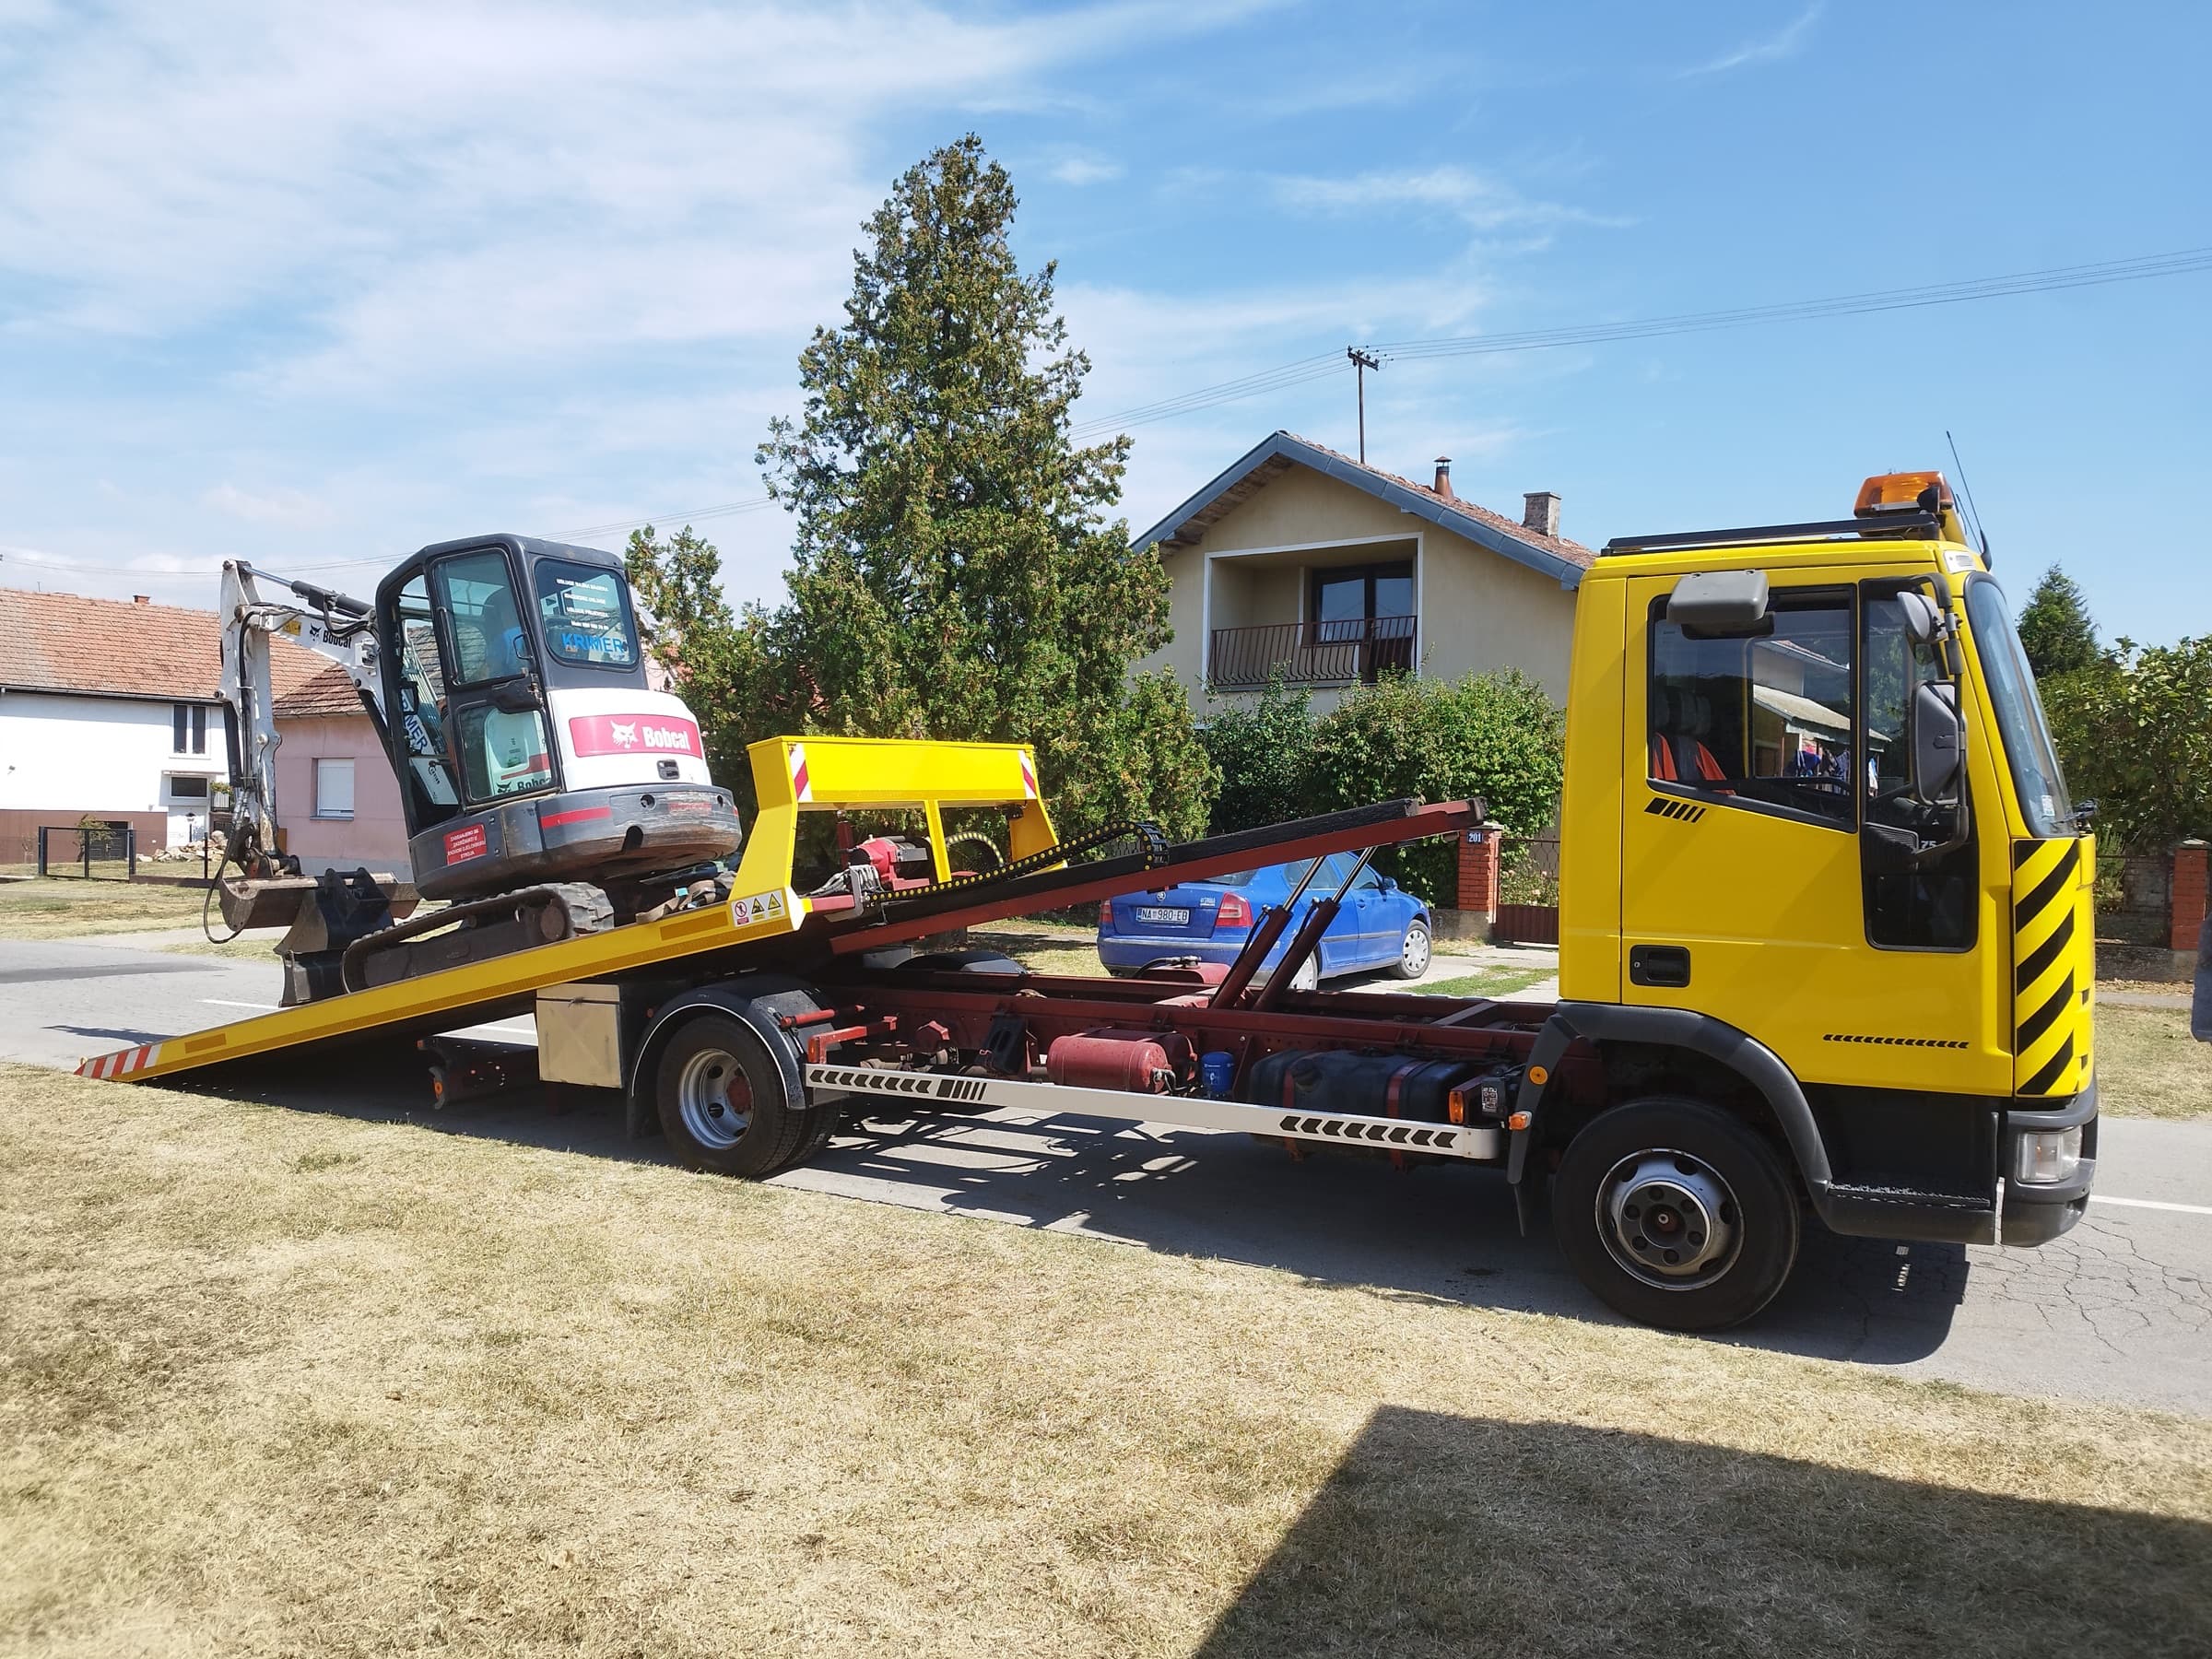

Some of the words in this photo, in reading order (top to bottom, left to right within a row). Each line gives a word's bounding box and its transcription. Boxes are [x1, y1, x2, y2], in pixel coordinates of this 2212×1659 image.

[561, 632, 624, 653] KRIMER
[641, 726, 690, 750] Bobcat
[1469, 833, 1481, 841] 201
[1142, 908, 1152, 919] NA
